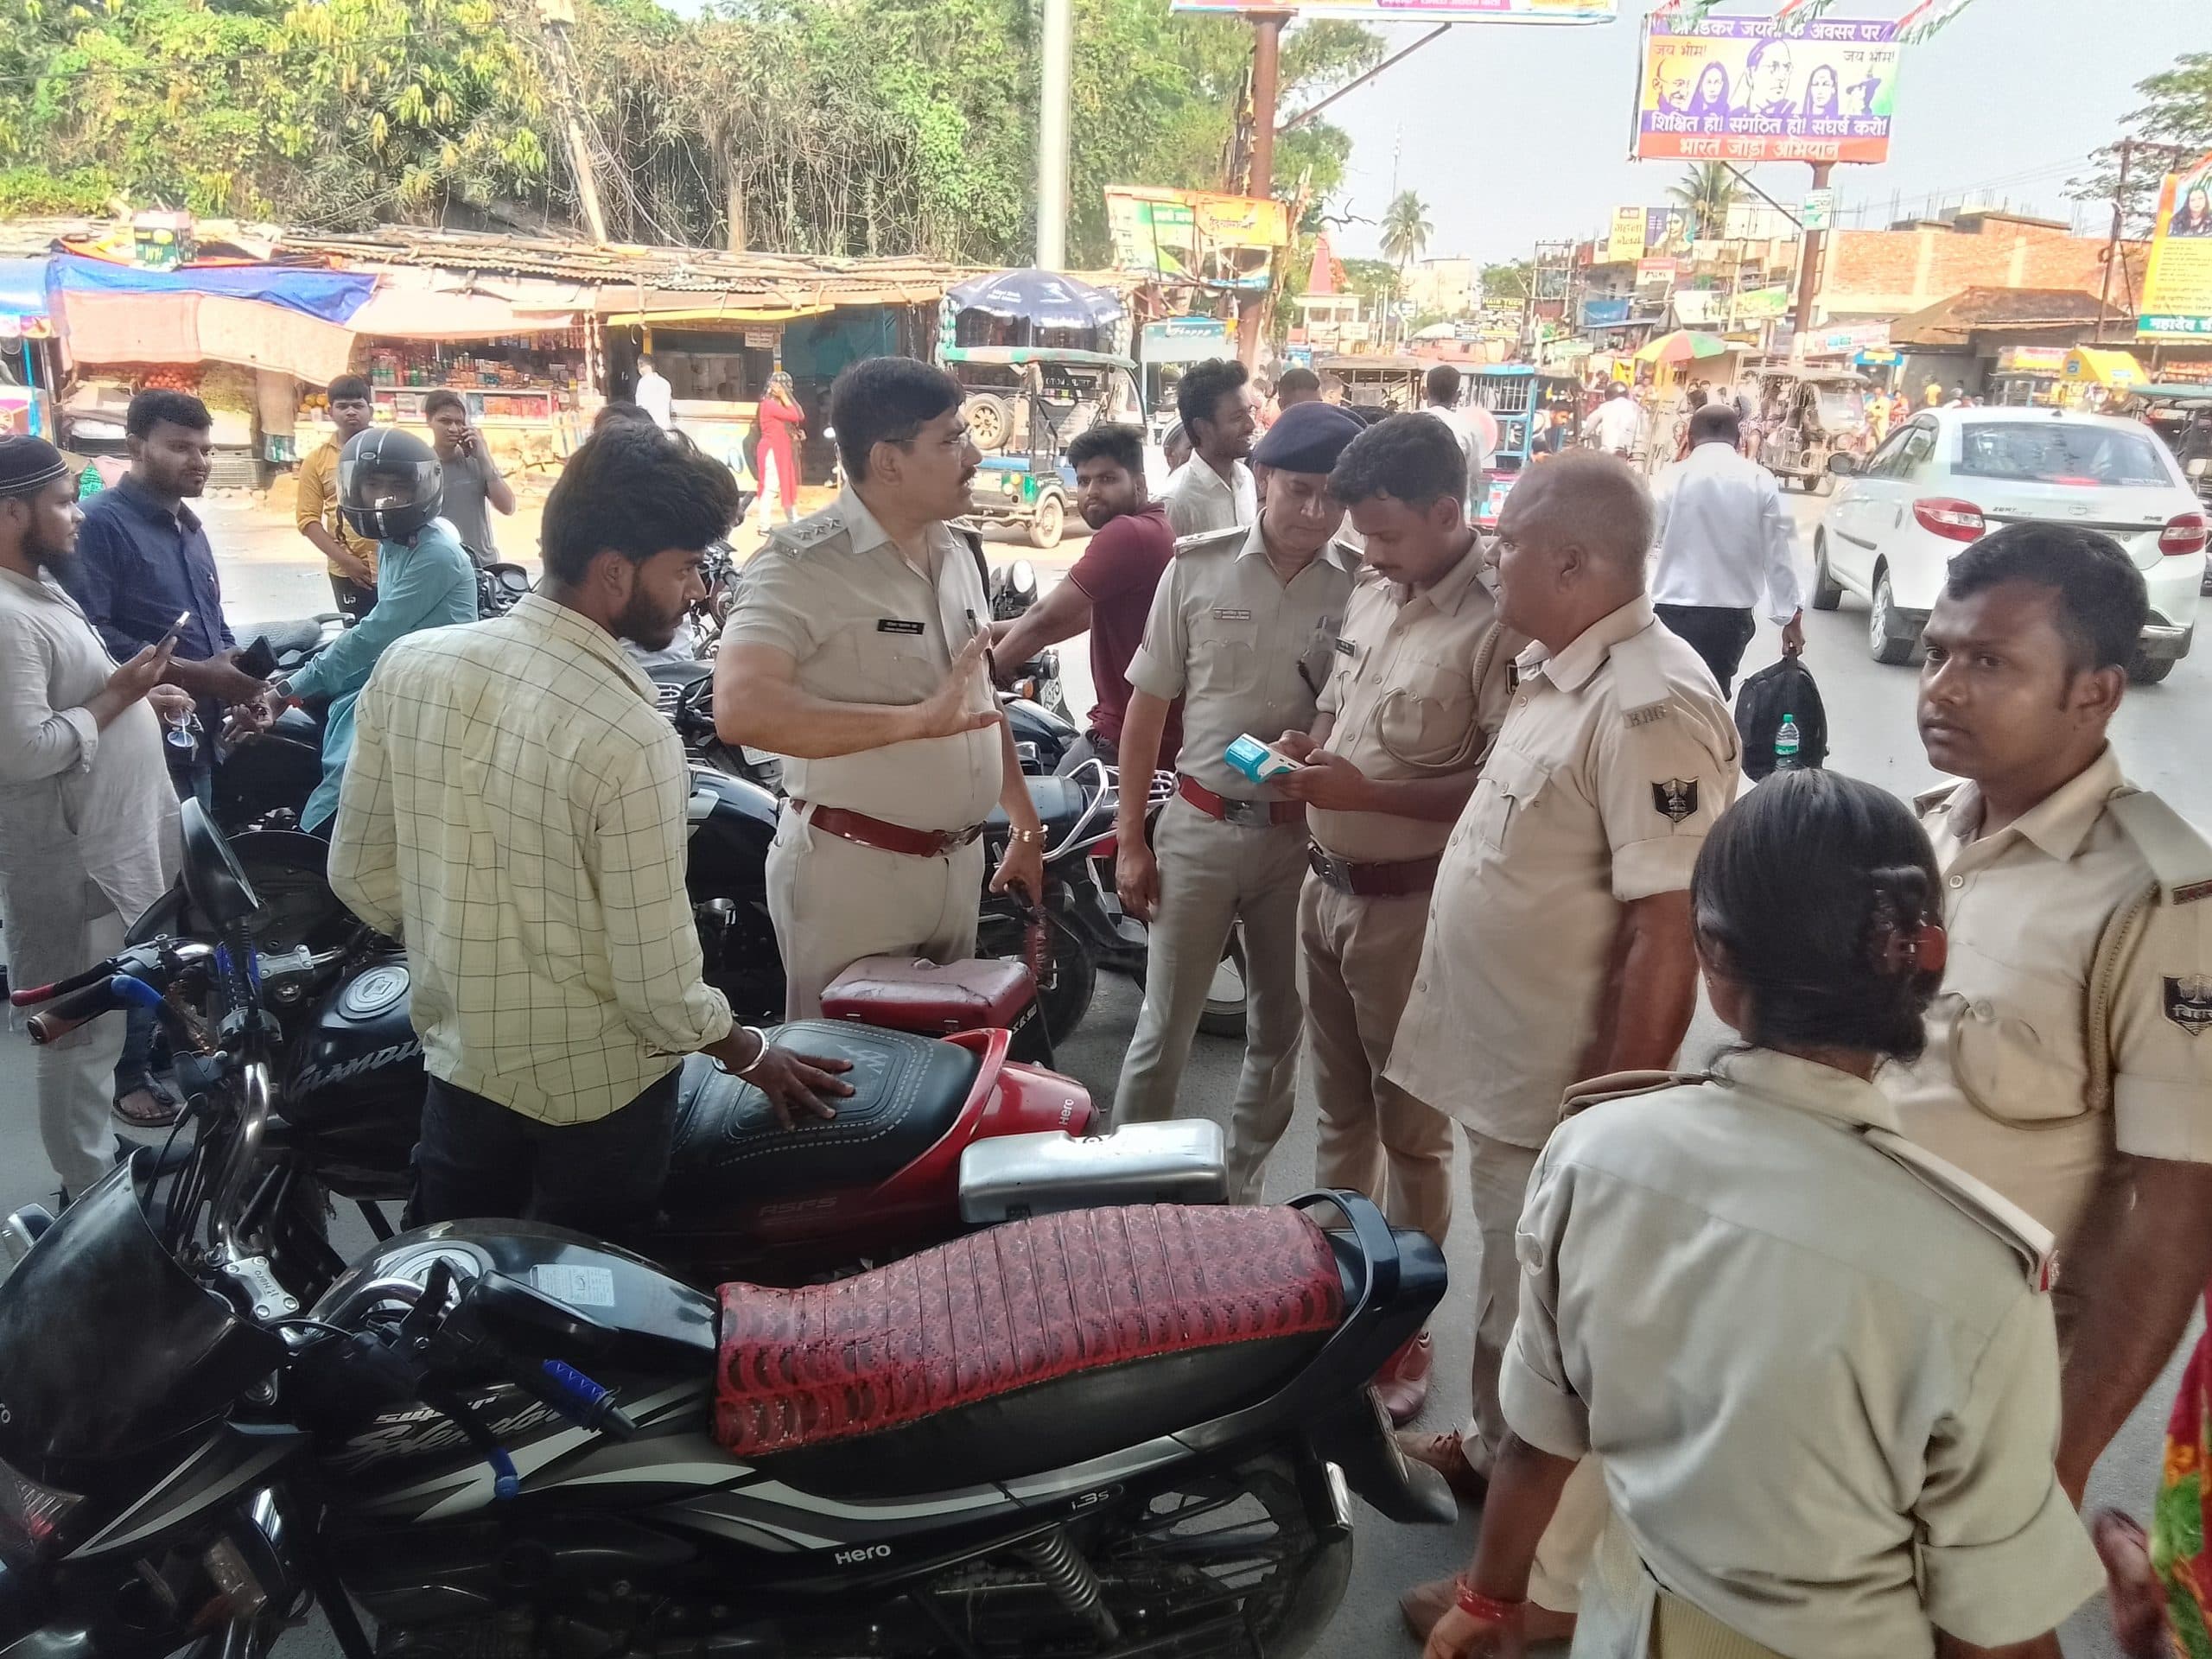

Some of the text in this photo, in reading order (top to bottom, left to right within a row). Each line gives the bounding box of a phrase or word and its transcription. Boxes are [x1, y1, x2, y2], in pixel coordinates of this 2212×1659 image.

[1810, 23, 1857, 41] अवसर
[1859, 25, 1882, 41] पर
[1654, 44, 1675, 55] जय
[1842, 50, 1865, 62] जय
[1651, 113, 1698, 132] शिक्षित
[1729, 114, 1783, 134] संगठित
[1812, 115, 1850, 136] संघर्ष
[1680, 137, 1720, 156] भारत
[1771, 137, 1840, 159] अभियान
[292, 1038, 424, 1092] GLAMOU
[1058, 1098, 1075, 1126] Hero
[835, 1544, 892, 1565] Hero
